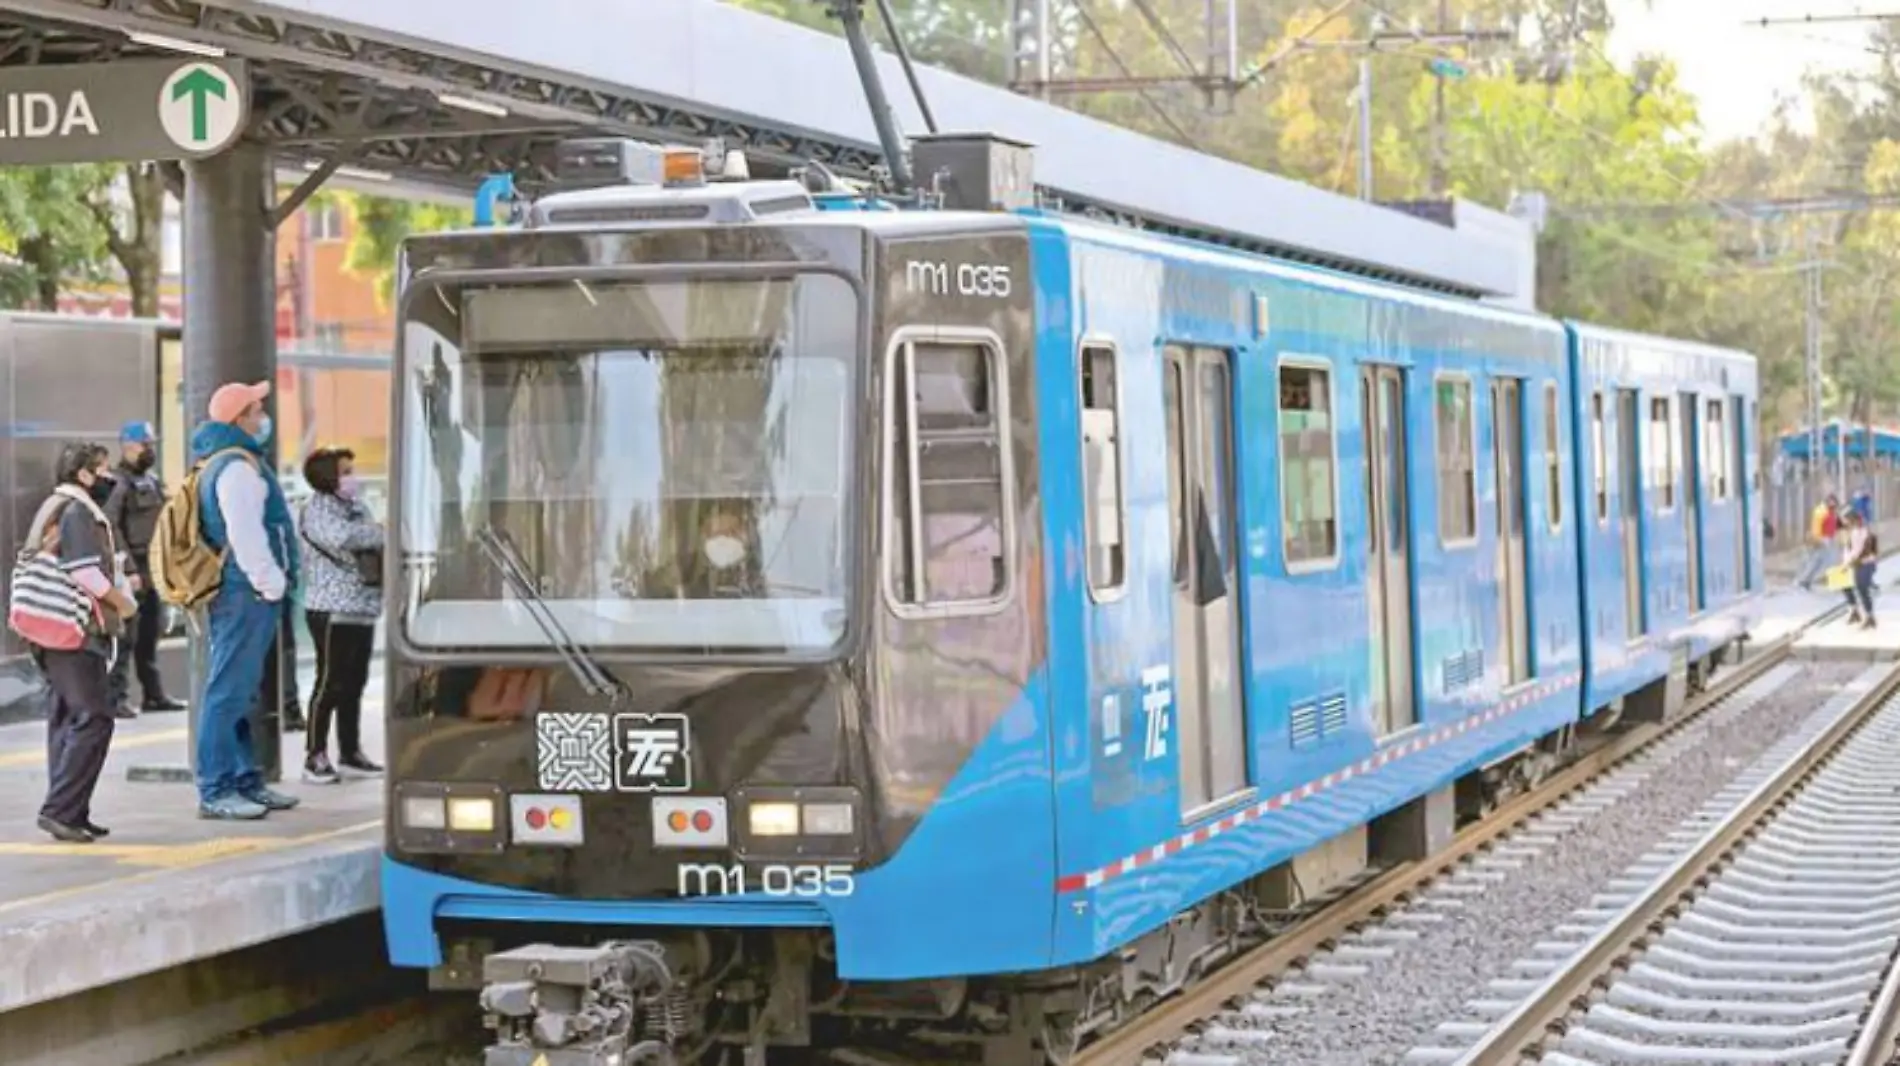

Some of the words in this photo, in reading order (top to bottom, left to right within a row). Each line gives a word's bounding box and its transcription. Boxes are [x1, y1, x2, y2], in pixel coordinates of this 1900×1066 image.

[0, 90, 100, 138] IDA
[957, 263, 1012, 298] 035
[761, 864, 855, 897] 035
